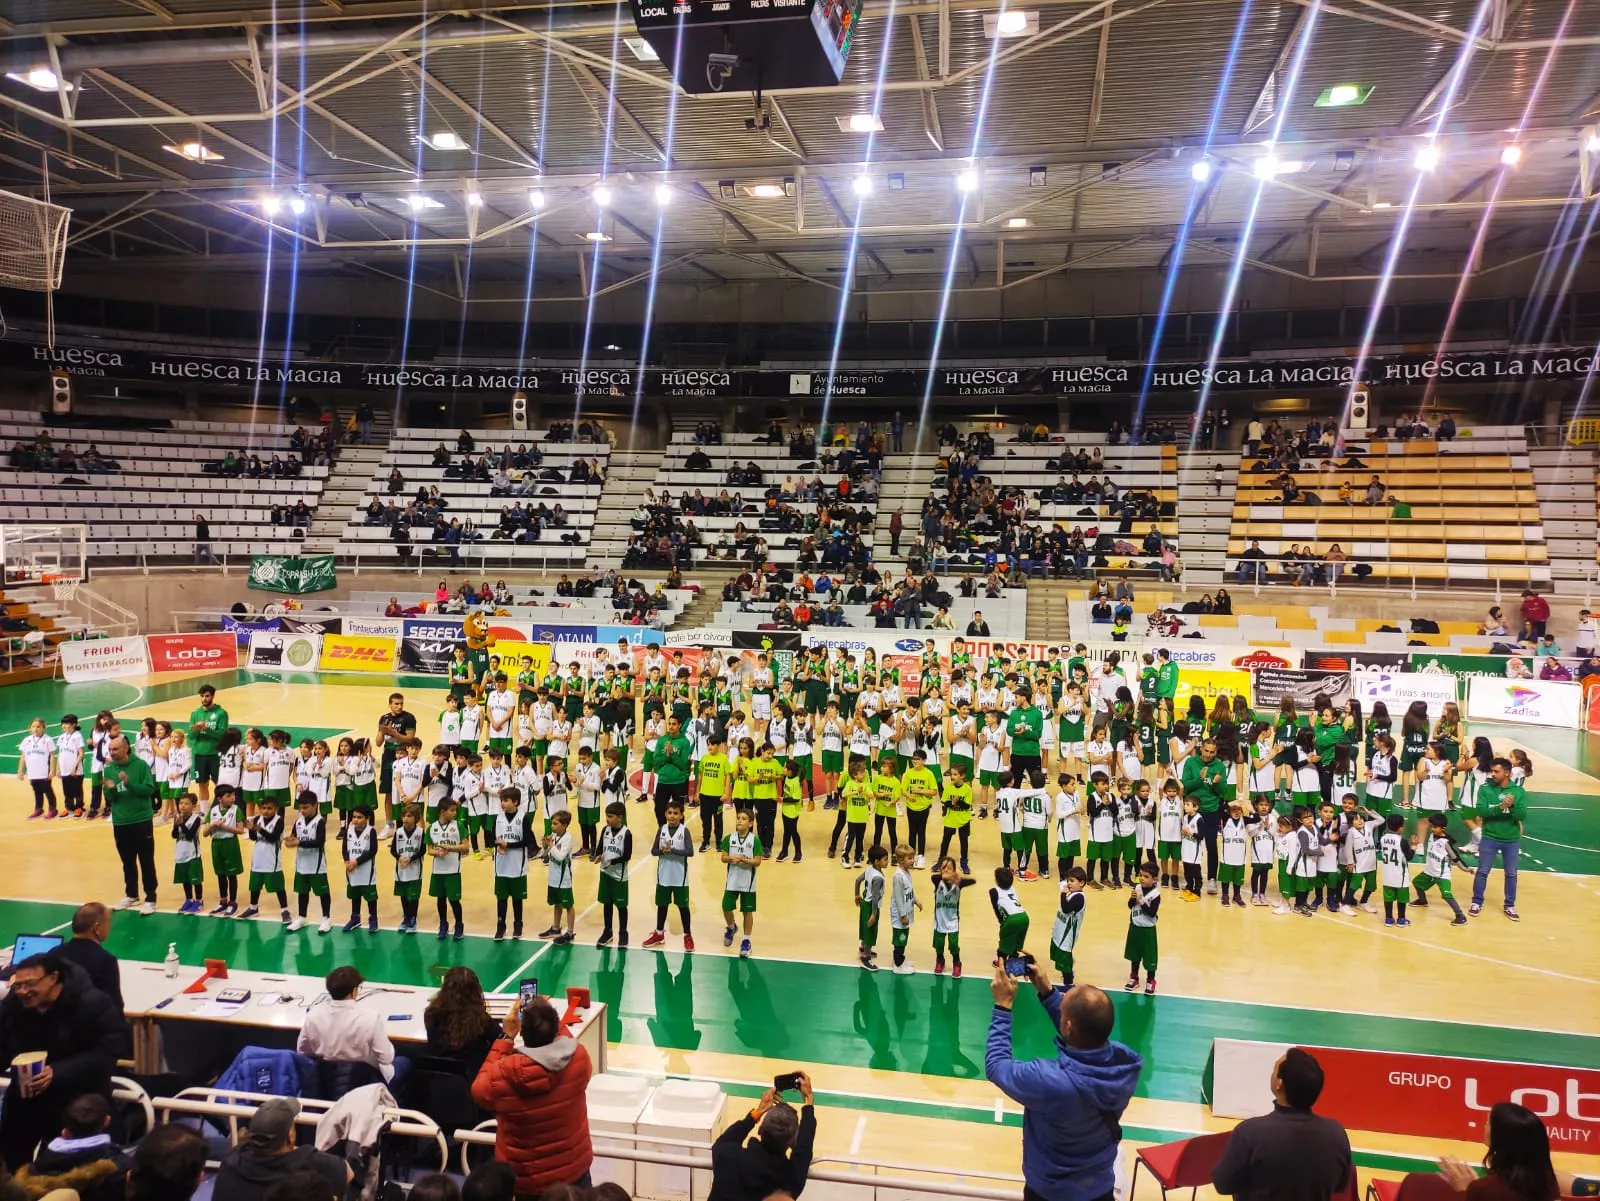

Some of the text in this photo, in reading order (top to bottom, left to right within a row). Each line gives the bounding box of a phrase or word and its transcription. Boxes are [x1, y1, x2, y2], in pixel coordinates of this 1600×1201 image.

[673, 6, 692, 14] FALTAS
[711, 3, 730, 11] JUGADOR
[750, 0, 805, 8] FALTAS VISITANTE
[640, 7, 667, 17] LOCAL
[814, 374, 884, 387] Ayuntamiento
[813, 385, 867, 395] de Huesca
[348, 620, 399, 634] Fontecabras
[409, 625, 462, 640] SERFEY
[557, 633, 593, 643] ATAIN
[83, 645, 123, 657] FRIBIN
[166, 647, 222, 660] Lobe
[329, 644, 393, 662] DHL
[1240, 657, 1285, 669] Ferrer
[1148, 677, 1155, 689] 2
[1395, 689, 1451, 700] rivas anoro
[1503, 706, 1541, 717] Zadisa
[1141, 726, 1150, 739] 3
[1188, 723, 1203, 737] 22
[1285, 724, 1291, 737] 1
[1335, 771, 1354, 788] 36
[1022, 796, 1043, 814] 90
[1382, 848, 1399, 866] 54
[1007, 893, 1021, 907] 5
[1388, 1071, 1451, 1090] GRUPO
